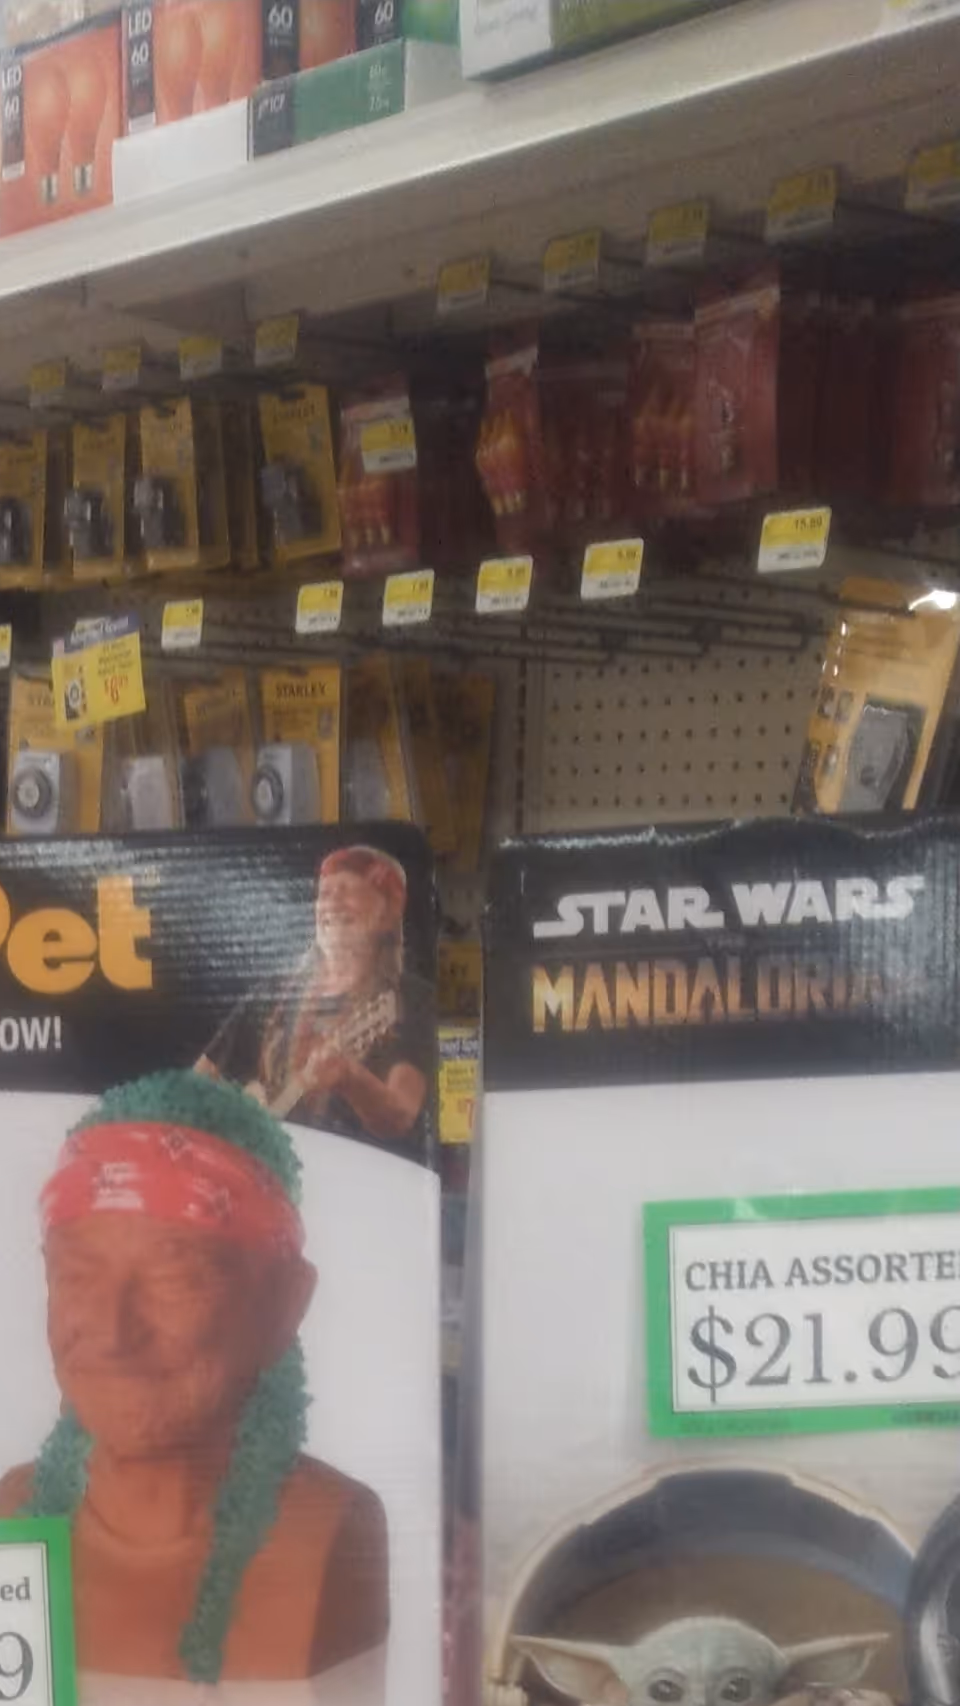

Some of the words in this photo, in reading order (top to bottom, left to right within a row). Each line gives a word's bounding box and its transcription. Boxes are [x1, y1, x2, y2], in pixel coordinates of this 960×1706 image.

[128, 9, 152, 36] LED
[269, 6, 293, 28] 60
[374, 3, 393, 24] 60
[131, 43, 149, 63] 60
[2, 65, 22, 90] LED
[4, 97, 20, 116] 60
[533, 887, 724, 938] STAR
[732, 875, 926, 926] WARS
[531, 957, 908, 1033] MANDALORIA
[685, 1257, 775, 1293] CHIA
[784, 1248, 960, 1287] ASSORTE
[686, 1304, 960, 1404] $21.99
